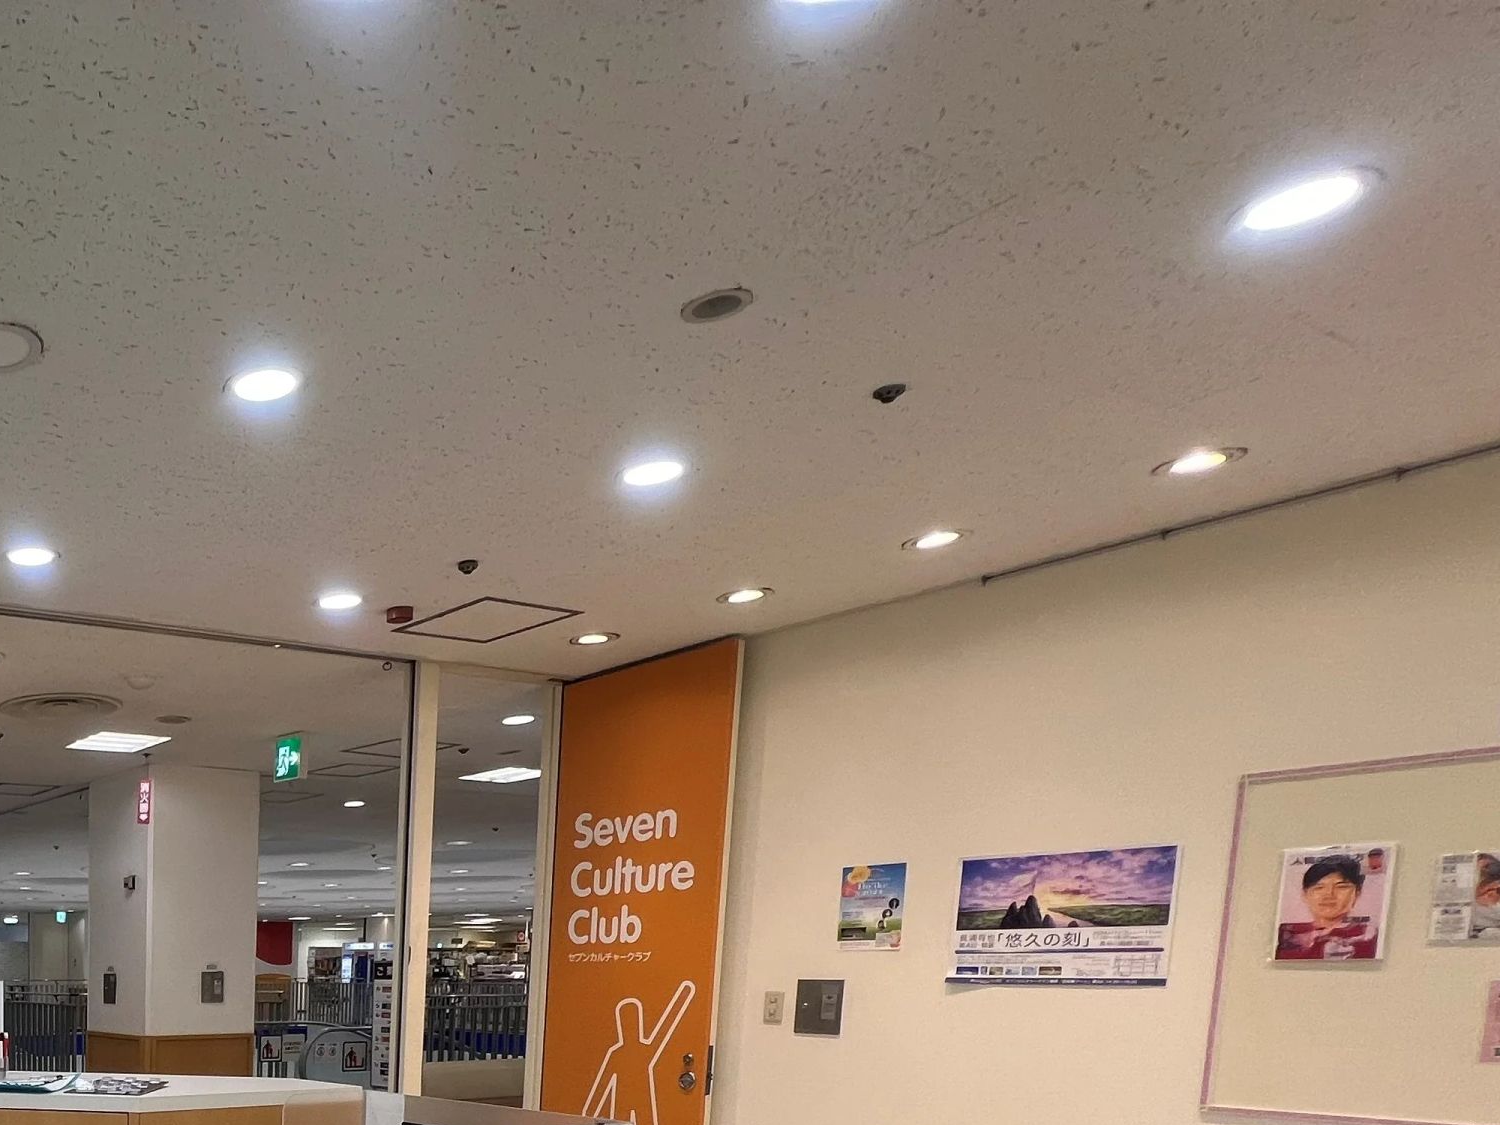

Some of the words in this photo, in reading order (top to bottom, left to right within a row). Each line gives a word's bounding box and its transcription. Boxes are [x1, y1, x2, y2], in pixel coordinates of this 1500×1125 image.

[573, 808, 678, 849] Seven
[570, 856, 695, 898] Culture
[567, 904, 642, 945] Club
[997, 931, 1090, 948] 「悠久の刻」
[568, 951, 652, 962] セブンカルチャークラブ
